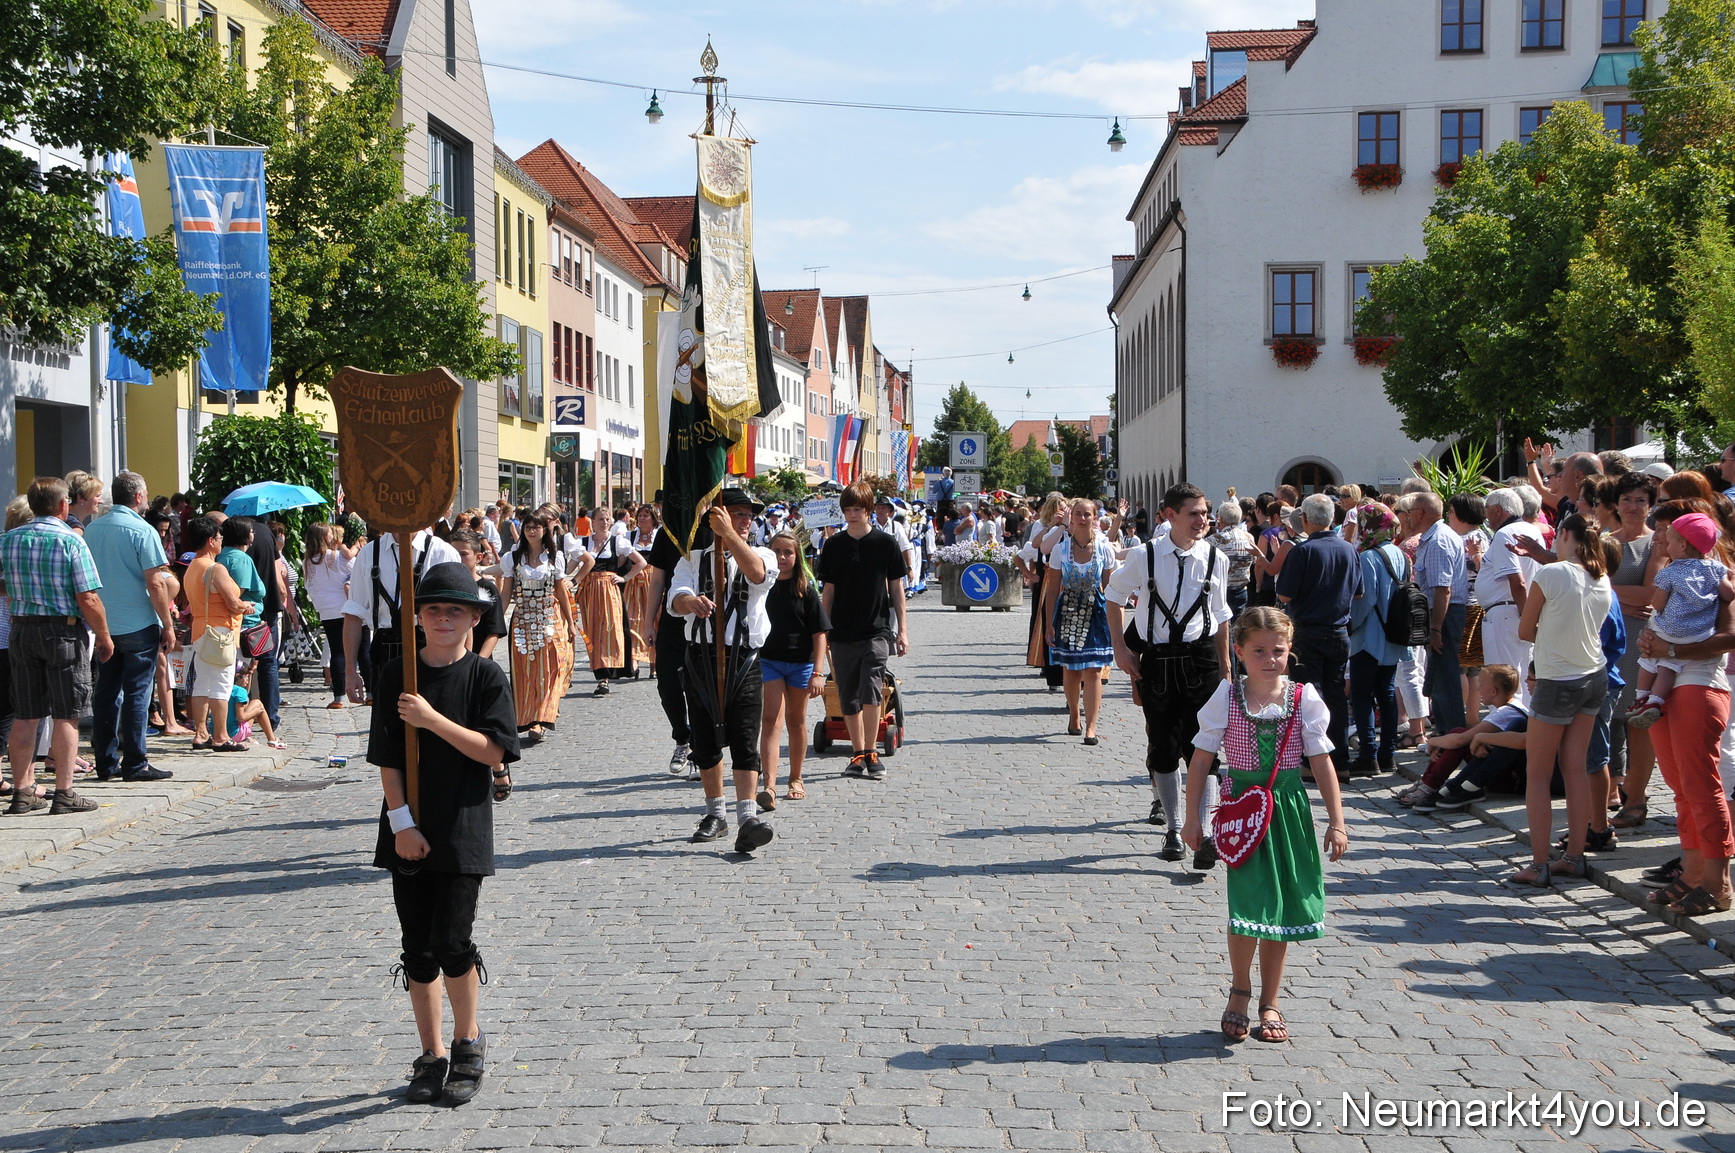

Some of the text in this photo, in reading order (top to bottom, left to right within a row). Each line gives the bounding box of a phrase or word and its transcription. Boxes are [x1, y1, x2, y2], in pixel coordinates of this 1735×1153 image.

[184, 261, 242, 270] Raiffeisenbank
[255, 271, 267, 280] eG
[559, 439, 569, 453] G2
[377, 482, 416, 506] Berg
[1220, 818, 1243, 834] mog
